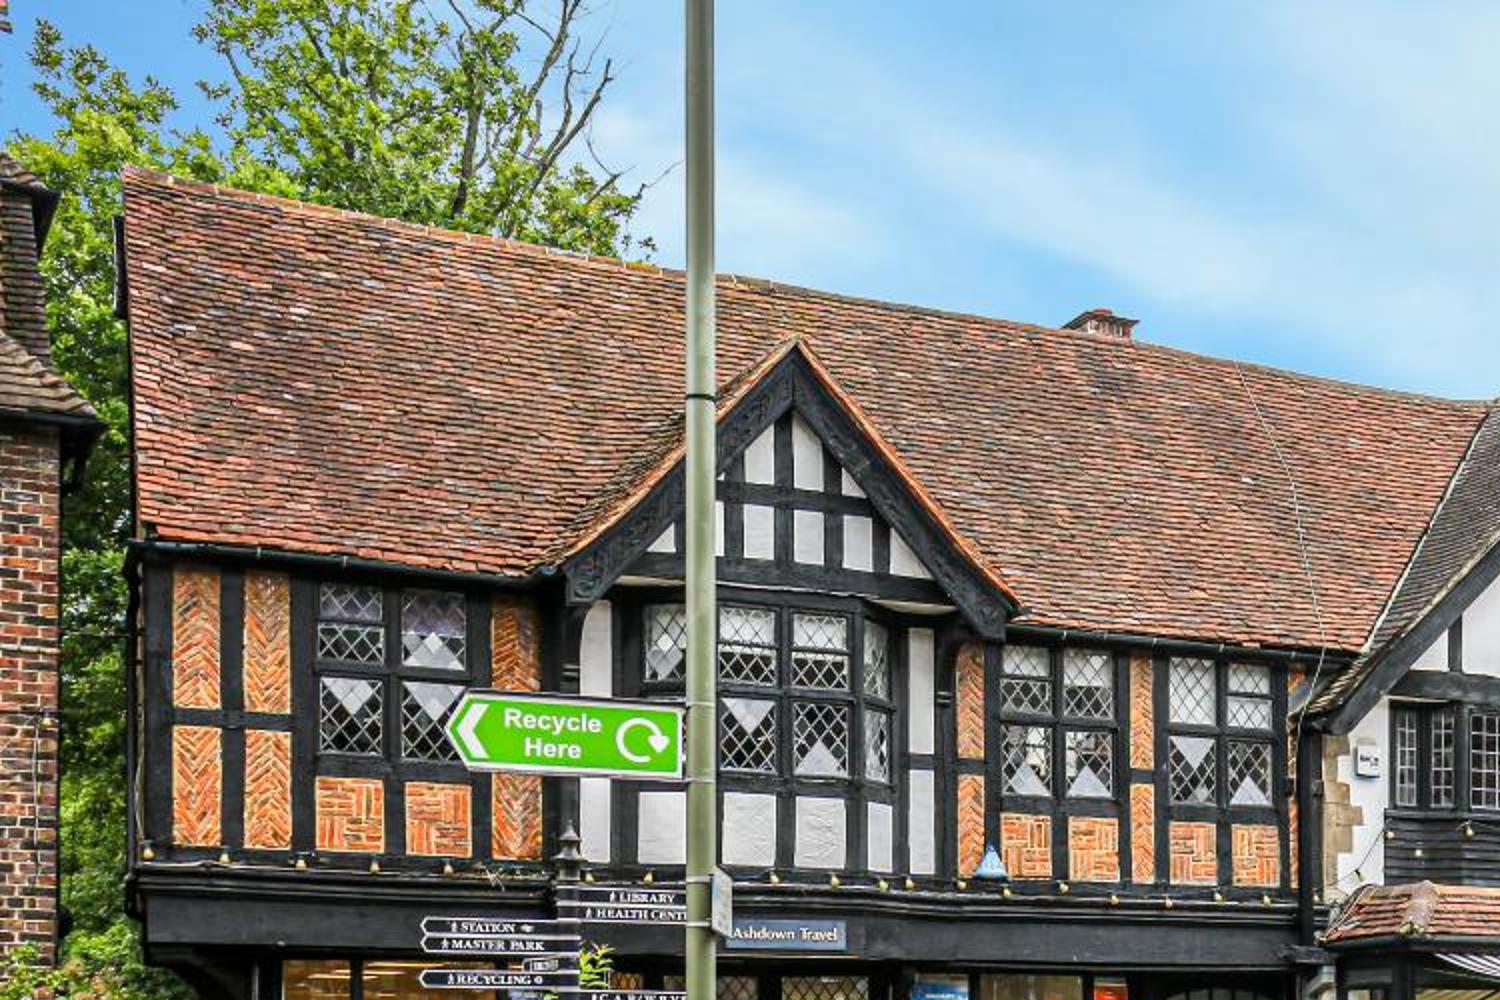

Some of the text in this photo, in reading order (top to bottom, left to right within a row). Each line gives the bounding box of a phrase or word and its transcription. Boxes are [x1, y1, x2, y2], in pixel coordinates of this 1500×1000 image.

[503, 707, 602, 734] Recycle
[524, 737, 582, 758] Here
[620, 892, 675, 903] LIBRARY
[597, 909, 648, 919] HEALTH
[461, 924, 516, 933] STATION
[734, 926, 837, 940] Ashdown Travel
[452, 939, 544, 951] MASTER PARK
[456, 974, 531, 985] RECYCLING
